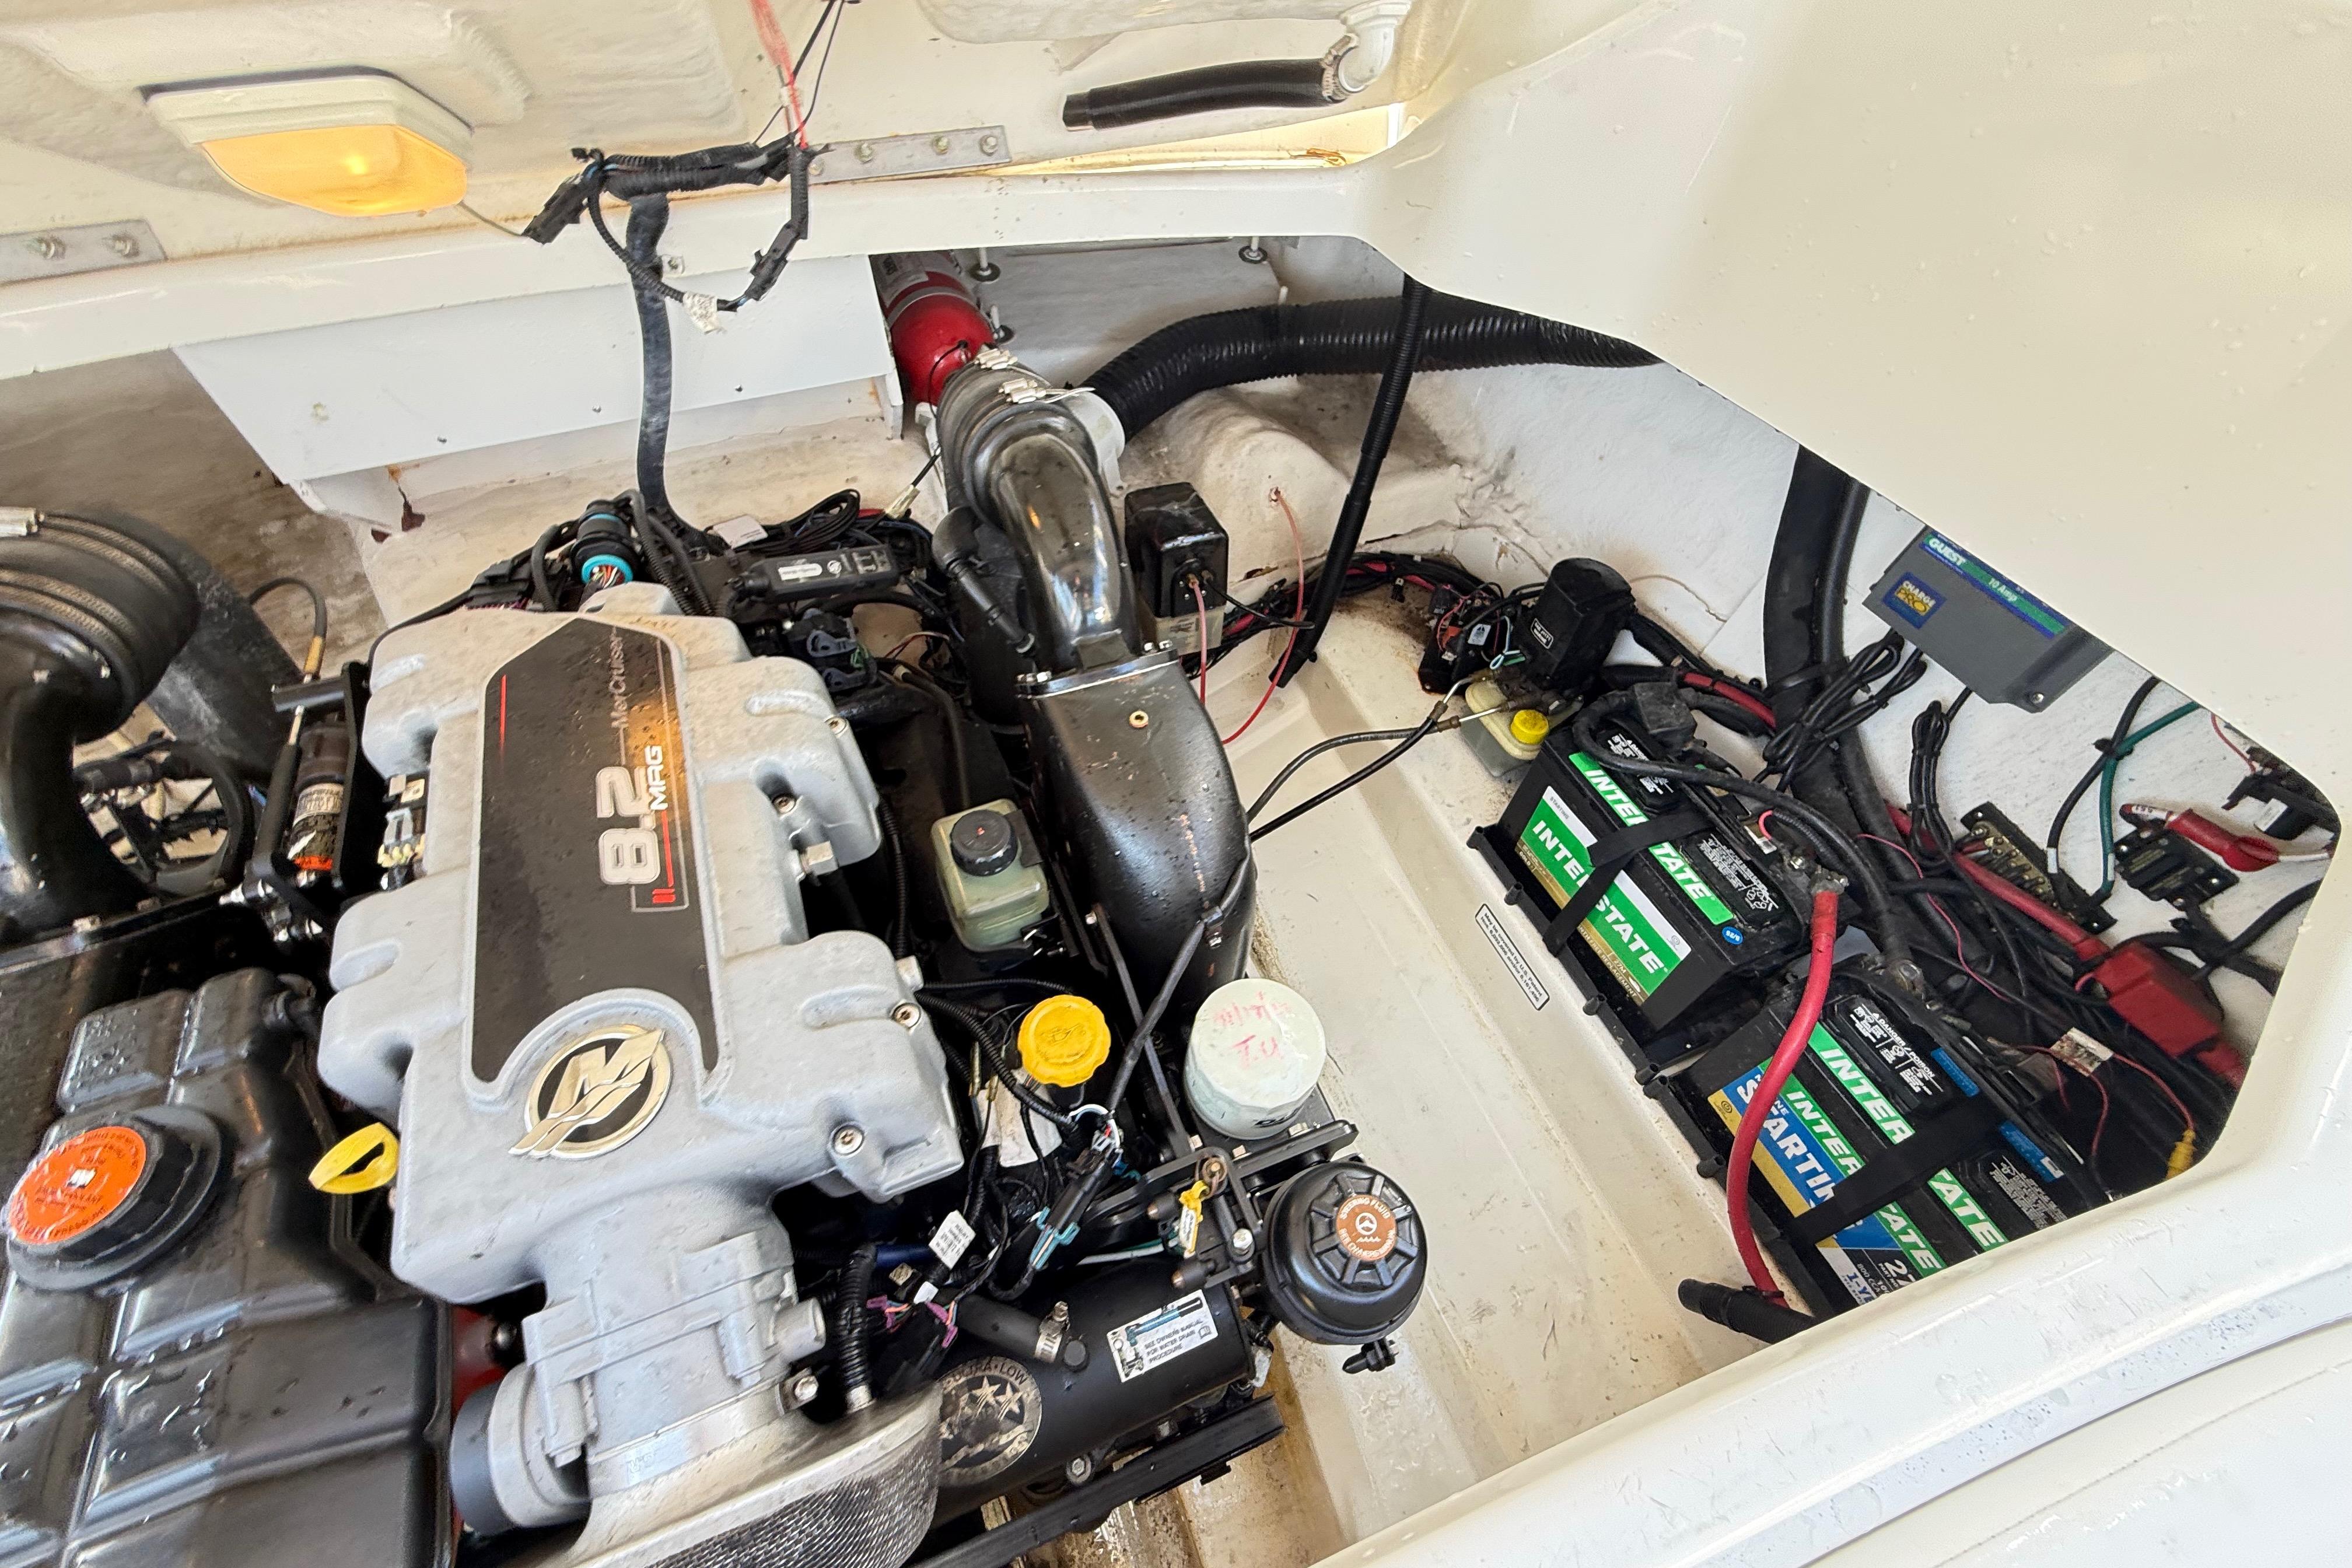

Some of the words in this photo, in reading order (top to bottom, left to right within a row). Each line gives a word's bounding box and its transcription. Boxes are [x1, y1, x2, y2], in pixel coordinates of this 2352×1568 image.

[1927, 537, 1966, 566] GUEST
[1896, 588, 1929, 613] PRO
[1902, 579, 1936, 607] CHARGE
[1988, 578, 1999, 589] 10
[1996, 584, 2018, 603] Amp
[608, 634, 629, 727] MerCruiser
[645, 745, 668, 810] MAG
[1550, 796, 1569, 819] STARTING
[595, 766, 660, 884] 8.2
[1497, 933, 1514, 956] covered
[1514, 956, 1520, 964] by
[1528, 977, 1542, 996] Patent
[1601, 954, 1637, 998] REPLACEMENT
[1878, 1019, 1906, 1046] DANGER
[1909, 1051, 1935, 1077] POISON
[1370, 1199, 1390, 1219] FLUID
[1856, 1263, 1870, 1278] 800
[1159, 1338, 1177, 1350] WATER
